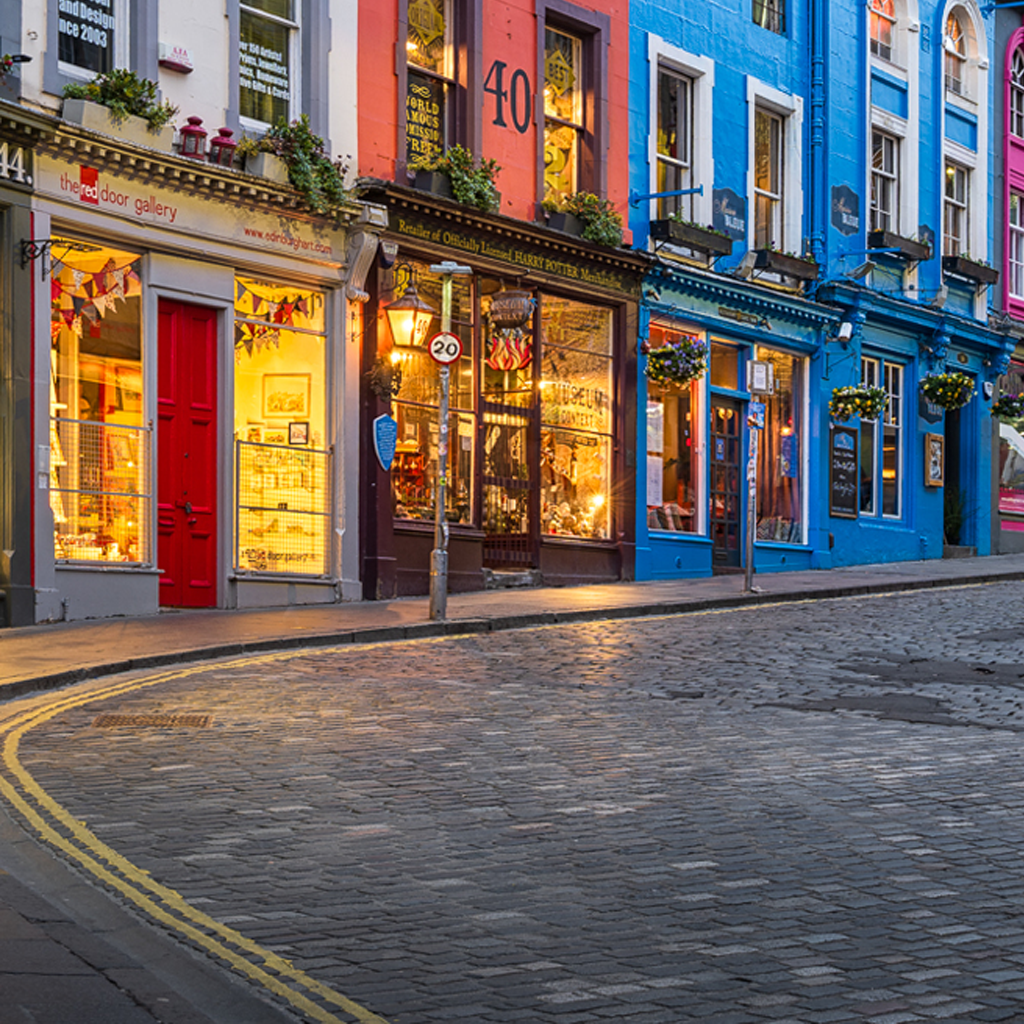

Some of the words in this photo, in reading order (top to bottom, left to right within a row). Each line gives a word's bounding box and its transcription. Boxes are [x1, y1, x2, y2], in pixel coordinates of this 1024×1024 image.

[80, 2, 114, 30] Design
[80, 24, 107, 49] 2003
[549, 63, 569, 83] BEST
[484, 59, 531, 134] 40
[60, 173, 80, 194] the
[80, 175, 98, 200] red
[100, 181, 129, 207] door
[135, 195, 177, 223] gallery
[243, 226, 333, 254] www.edinburghart.com
[398, 219, 430, 239] Retailer
[432, 229, 441, 242] of
[443, 231, 480, 255] Officially
[481, 240, 512, 262] Licensed
[514, 251, 544, 270] HARRY
[545, 259, 579, 280] POTTER
[433, 340, 458, 357] 20
